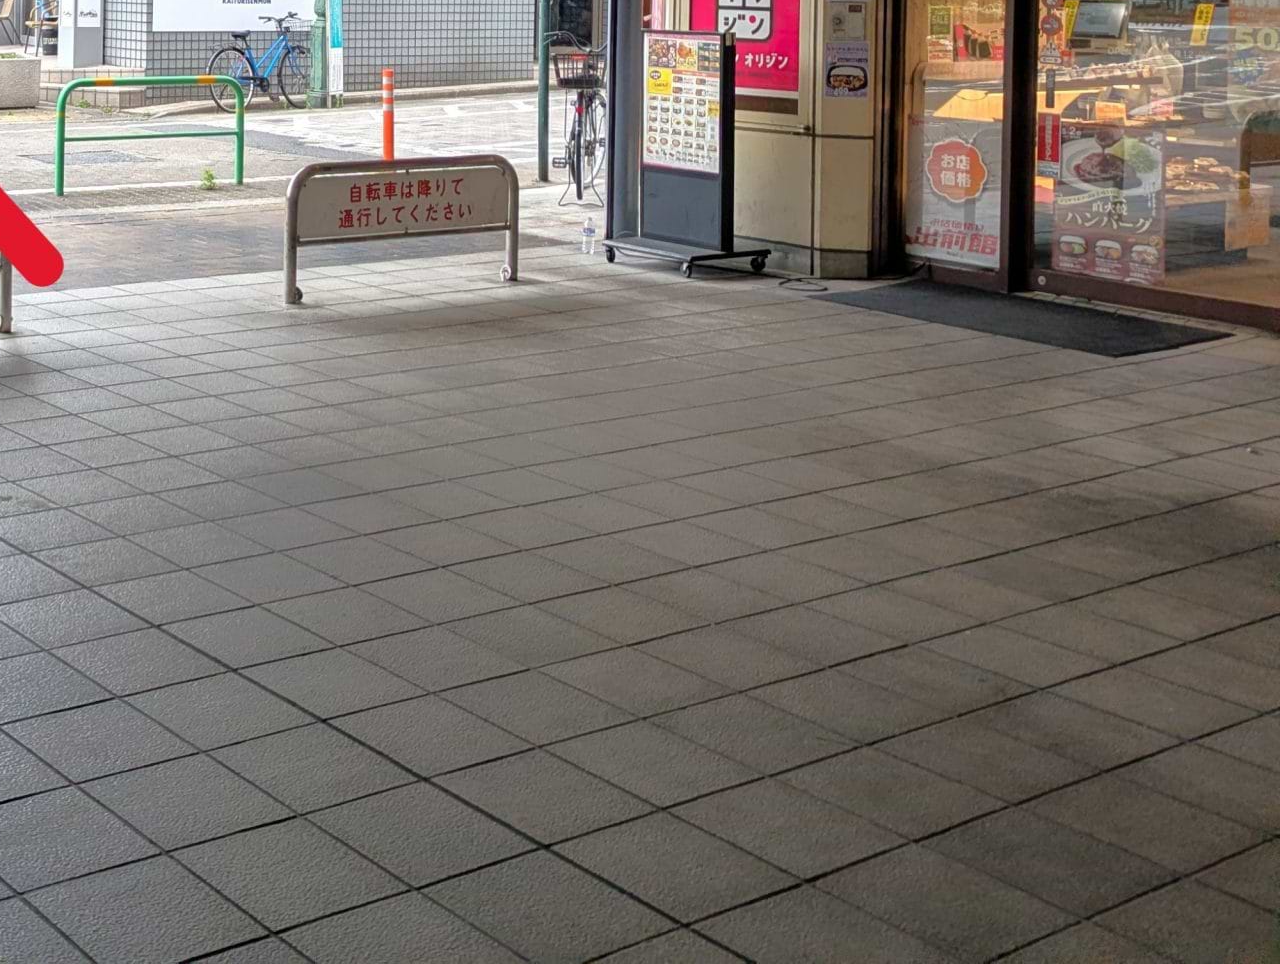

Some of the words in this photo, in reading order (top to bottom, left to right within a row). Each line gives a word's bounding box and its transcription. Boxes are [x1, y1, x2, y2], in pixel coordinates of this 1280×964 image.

[744, 52, 789, 70] オリジン
[940, 154, 970, 170] お店
[940, 171, 971, 188] 価格
[350, 178, 464, 203] 自転車は降りて
[338, 202, 472, 229] 通行してください
[1065, 211, 1153, 234] ハンバーグ
